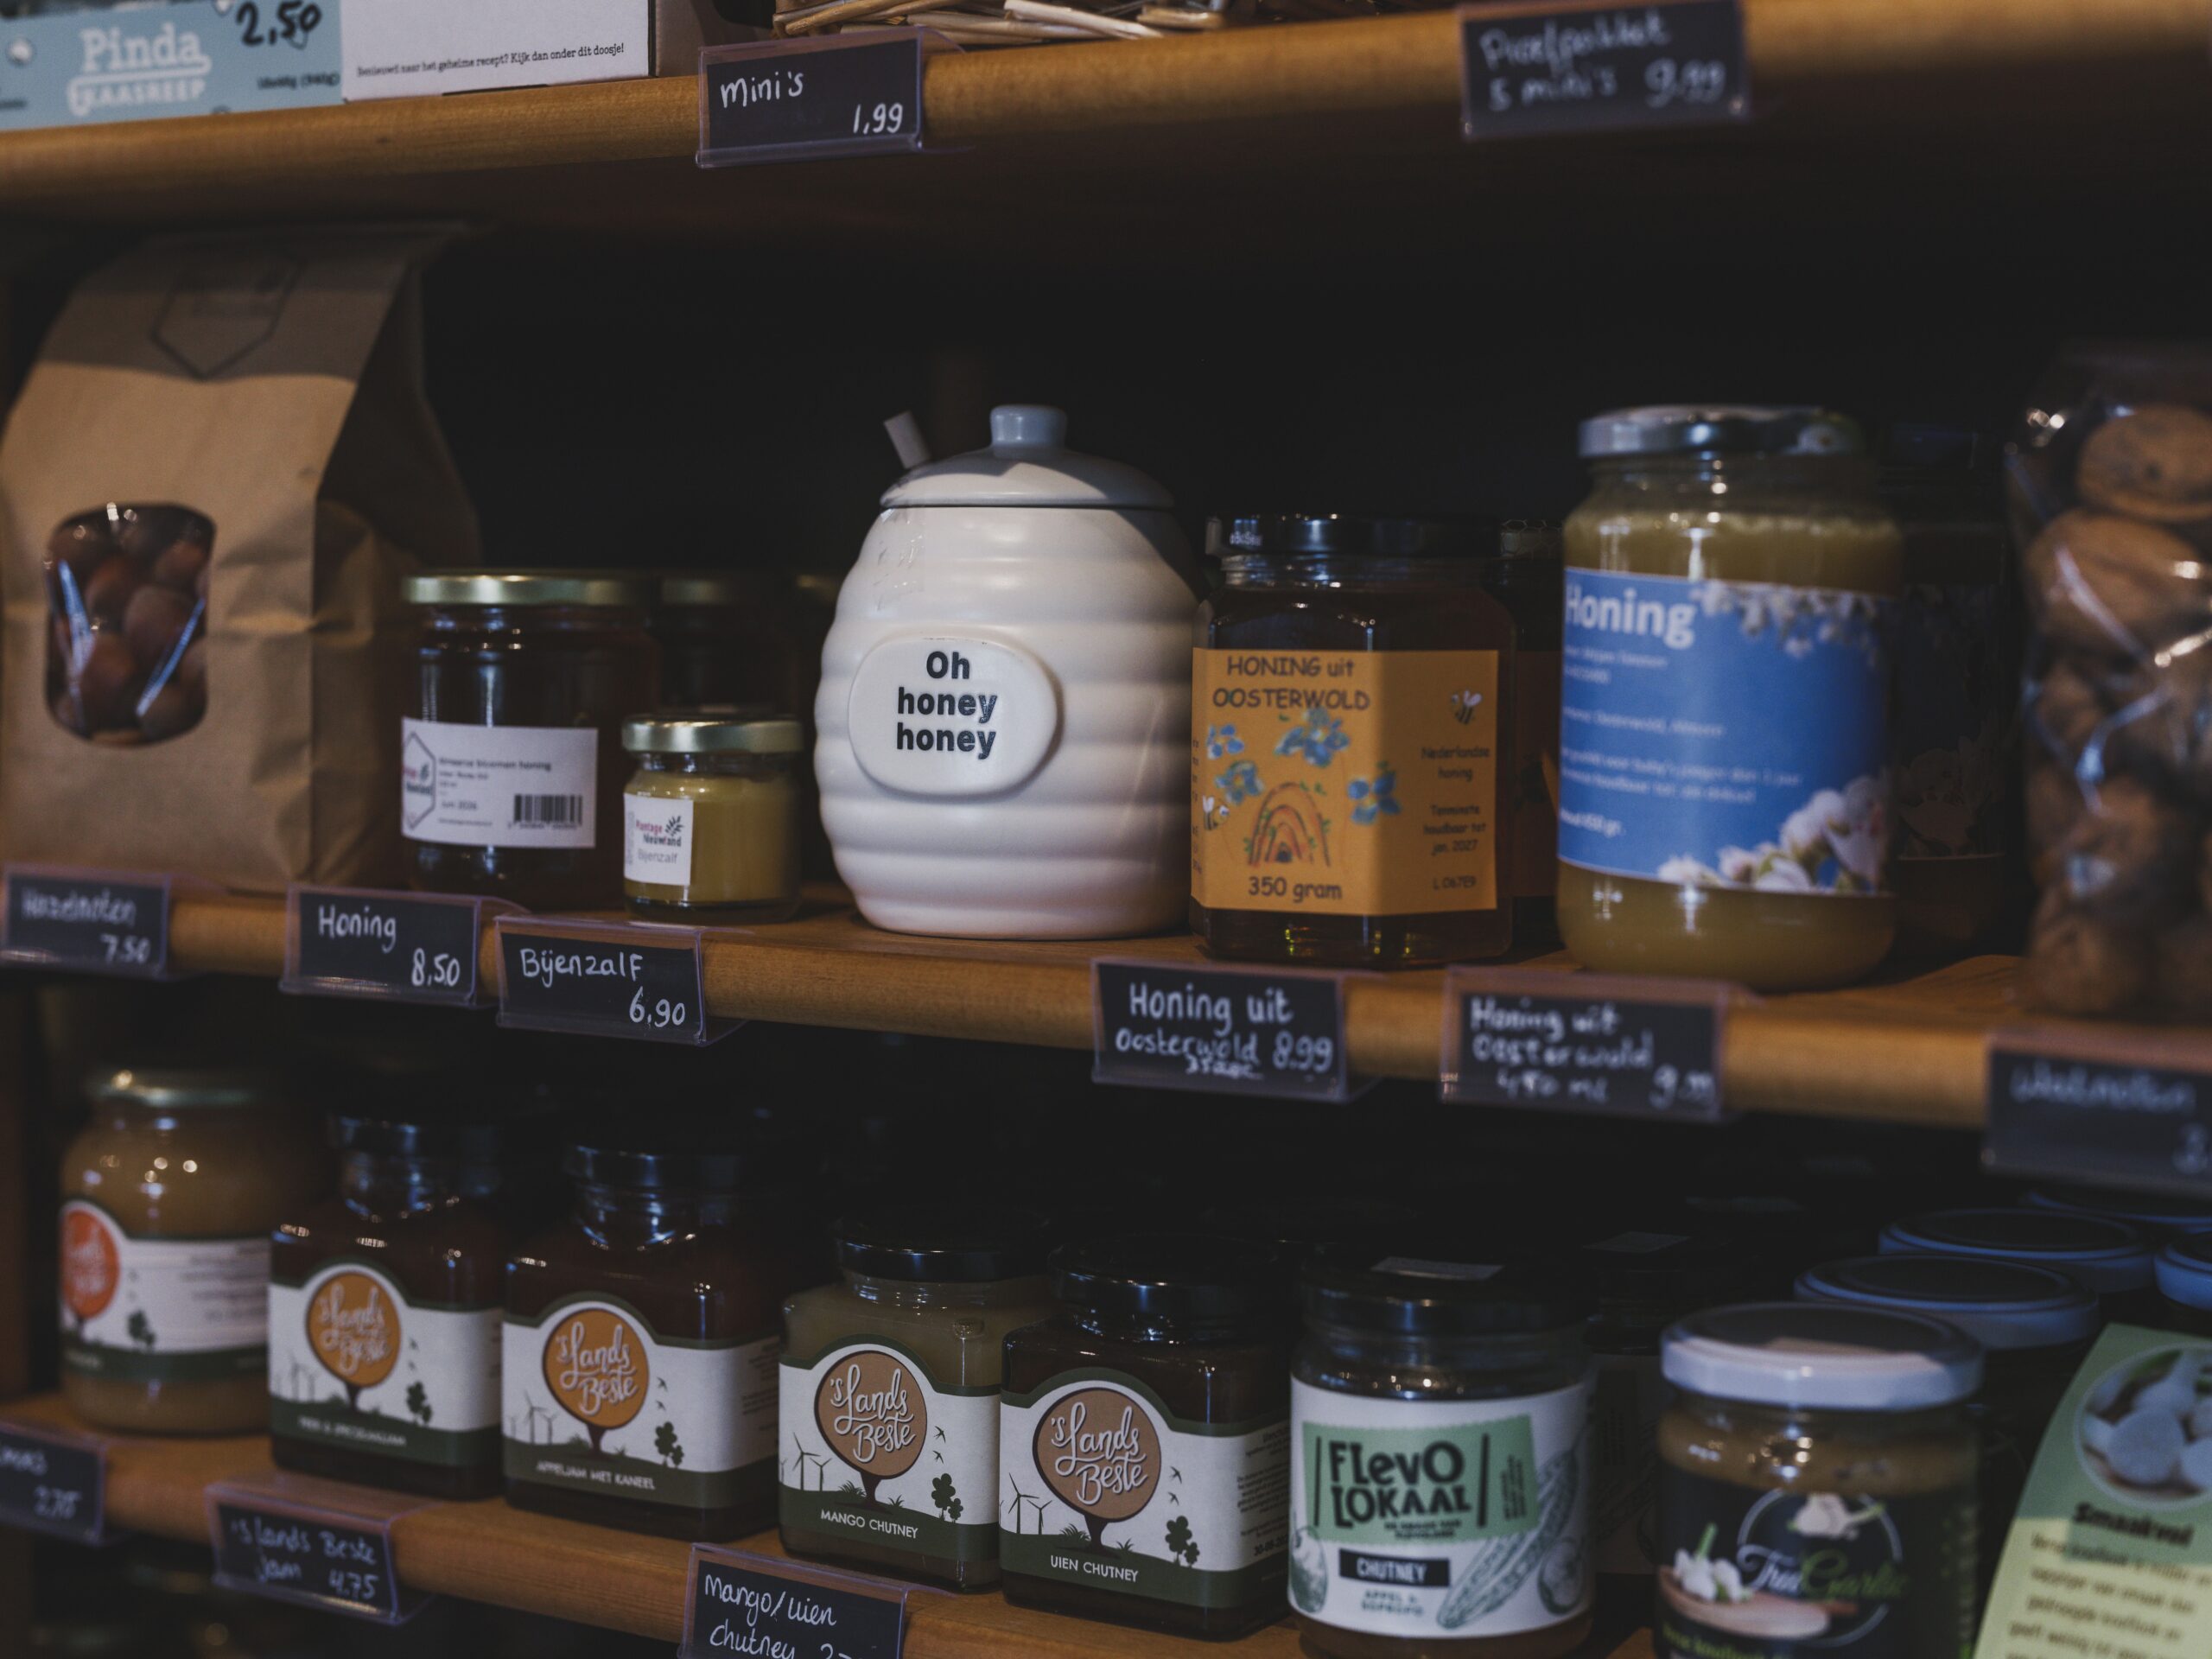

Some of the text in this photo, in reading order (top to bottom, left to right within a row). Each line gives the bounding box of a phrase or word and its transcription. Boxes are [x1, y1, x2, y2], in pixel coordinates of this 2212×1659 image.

[79, 22, 202, 72] Pinda
[476, 54, 508, 69] recept?
[511, 51, 531, 66] Kijk
[532, 49, 549, 61] dan
[550, 48, 576, 60] onder
[578, 45, 592, 57] dit
[593, 43, 624, 58] doosje!
[852, 102, 904, 135] 1,99
[1563, 585, 1697, 651] Honing
[925, 651, 970, 679] Oh
[1226, 655, 1355, 678] HONING uit
[897, 686, 998, 724] honey
[1211, 688, 1370, 711] OOSTERWOLD
[896, 722, 997, 760] honey
[1248, 875, 1343, 904] 350 gram
[318, 903, 397, 954] Honing
[410, 947, 461, 988] 8,50
[628, 985, 686, 1027] 6,90
[1128, 982, 1294, 1037] Honing uit
[1470, 995, 1567, 1044] Honing
[1114, 1026, 1262, 1067] Oosterwold
[560, 1320, 637, 1391] Lands
[578, 1368, 640, 1416] Beste
[834, 1363, 909, 1435] Lands
[851, 1412, 917, 1463] Beste
[1054, 1401, 1141, 1477] Lands
[589, 1470, 612, 1484] MET
[614, 1472, 656, 1491] KANEEL
[1075, 1452, 1148, 1505] Beste
[820, 1509, 919, 1539] MANGO CHUTNEY
[1330, 1484, 1472, 1529] LOKAAL
[1050, 1554, 1140, 1583] UIEN CHUTNEY
[1356, 1556, 1428, 1584] CHUTNEY
